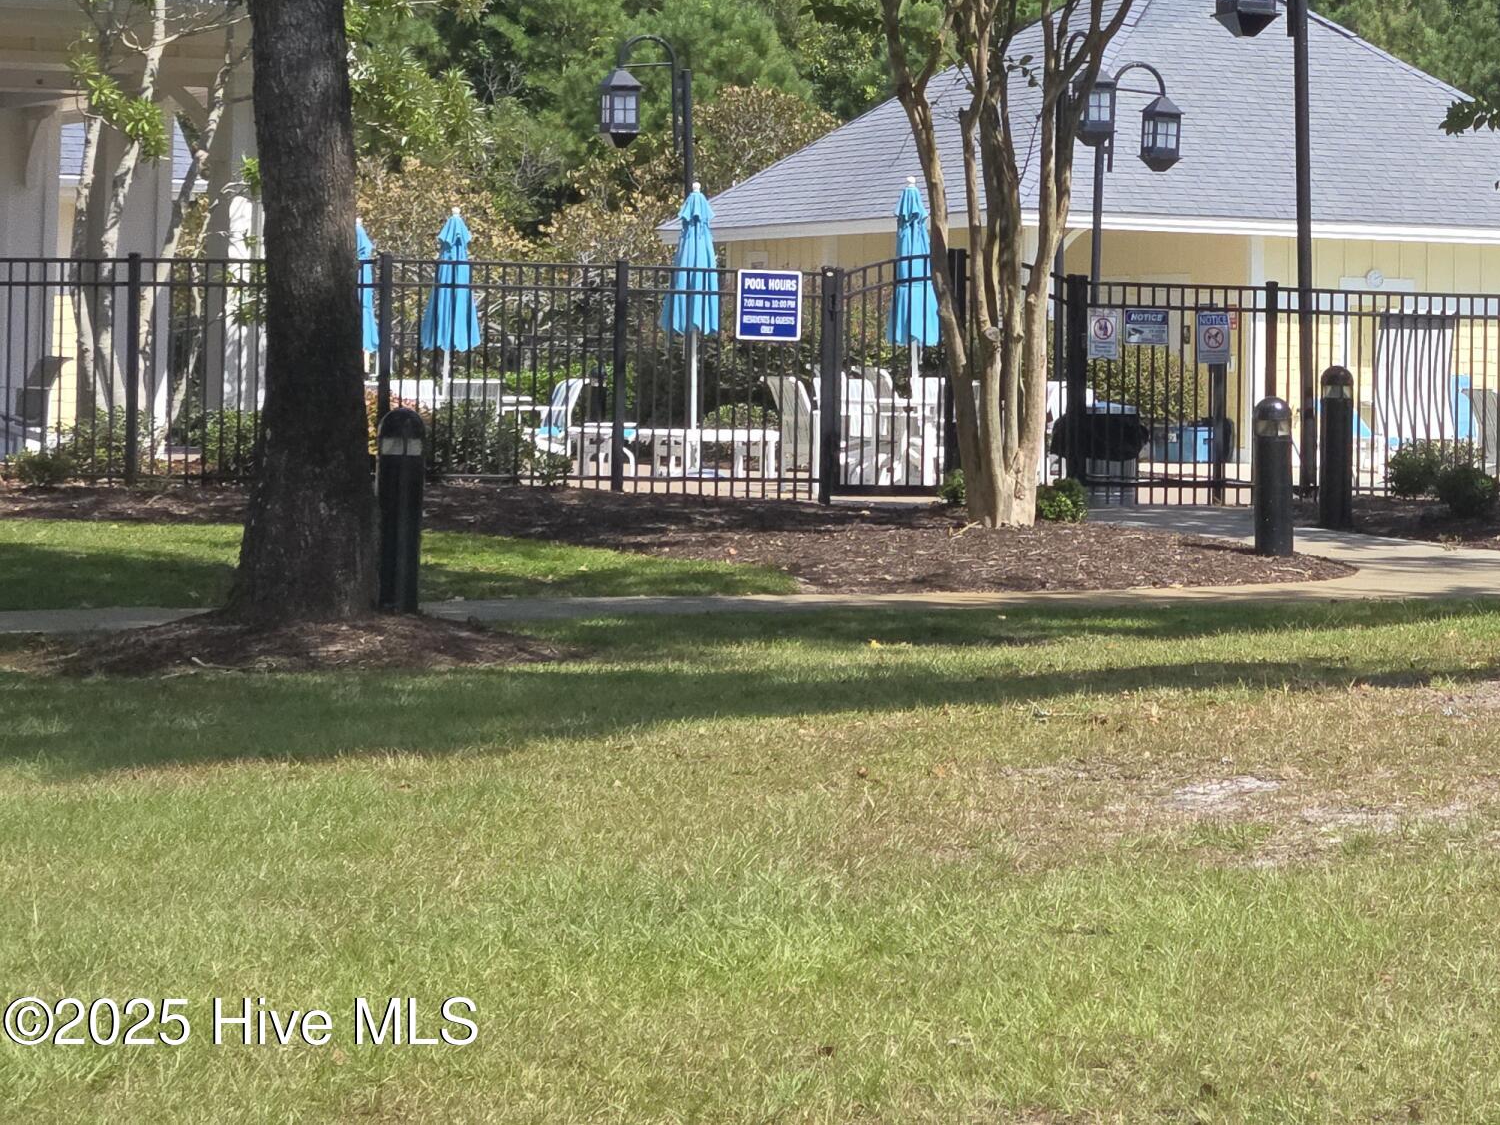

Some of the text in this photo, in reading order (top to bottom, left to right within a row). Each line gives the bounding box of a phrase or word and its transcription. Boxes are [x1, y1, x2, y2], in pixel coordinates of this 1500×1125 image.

[744, 278, 797, 291] POOL HOURS
[744, 299, 755, 307] 7:00
[755, 299, 764, 307] AM
[771, 300, 786, 308] 10:00
[787, 300, 796, 308] PM
[1130, 313, 1164, 322] NOTICE
[1200, 315, 1228, 324] NOTICE
